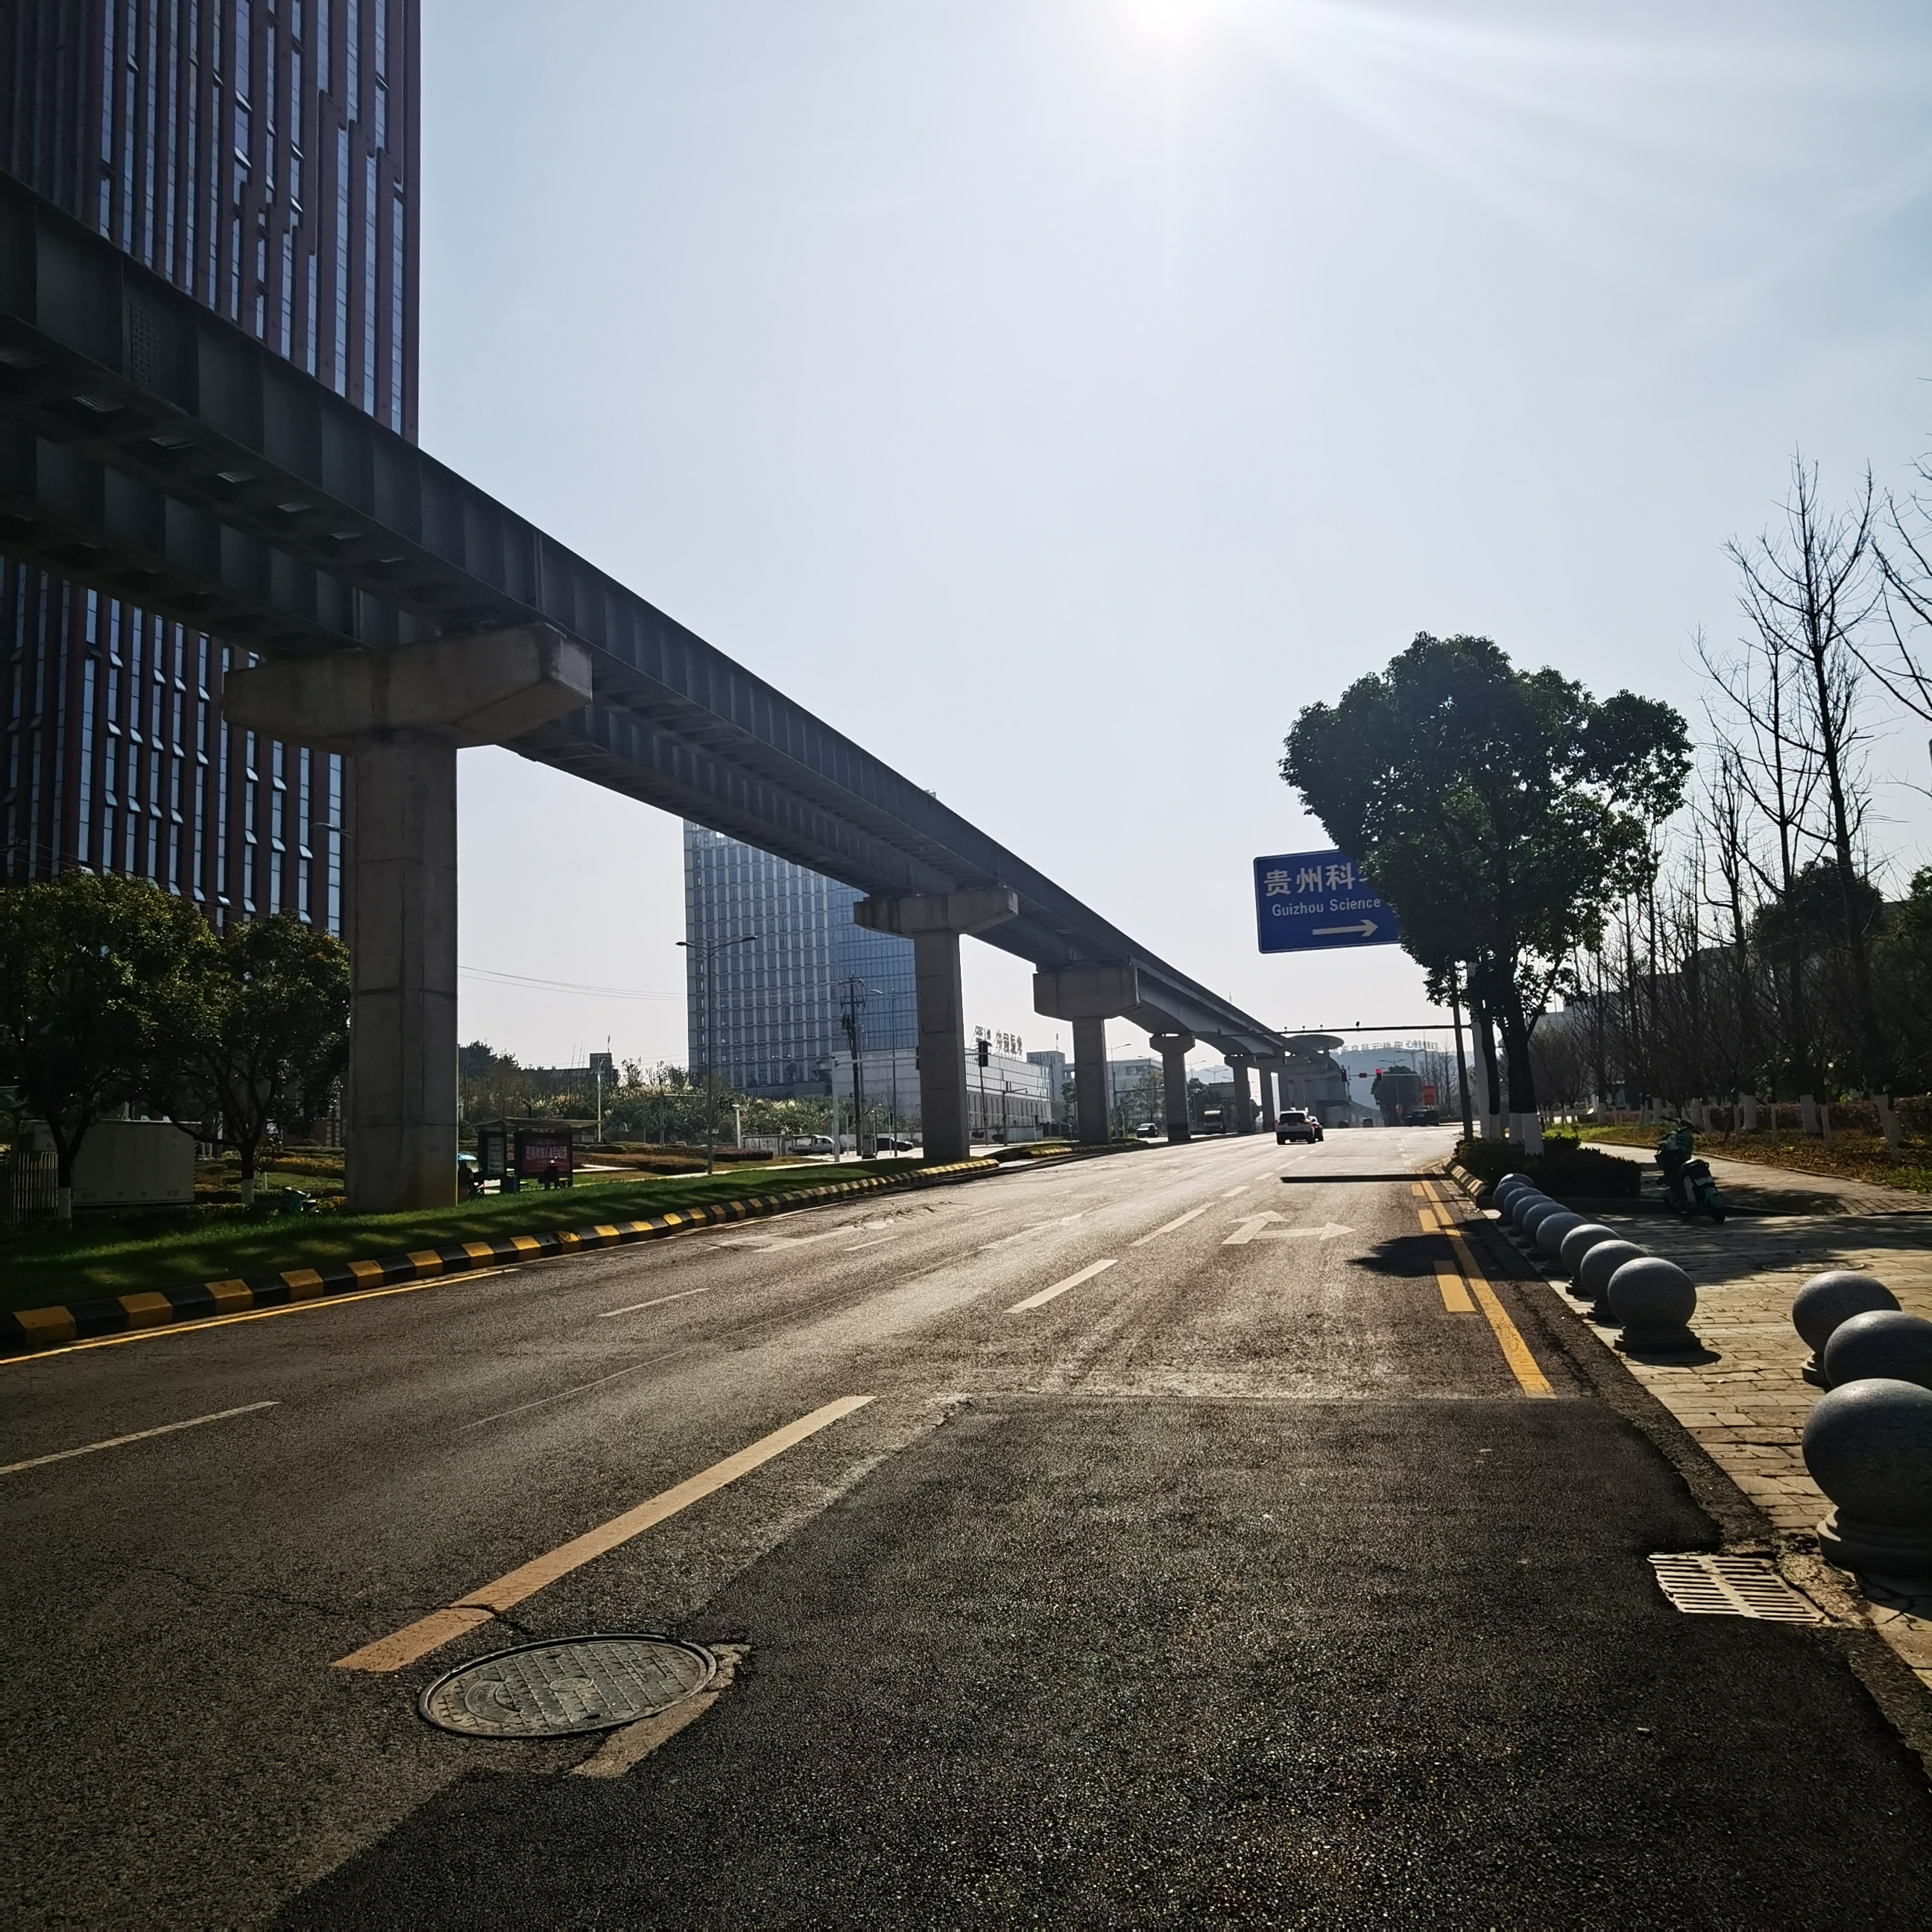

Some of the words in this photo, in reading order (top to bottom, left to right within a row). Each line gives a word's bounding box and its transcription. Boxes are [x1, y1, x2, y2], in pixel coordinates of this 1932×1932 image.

[1263, 862, 1368, 897] 贵州科
[1272, 901, 1325, 917] Guizhou
[1330, 897, 1381, 912] Science
